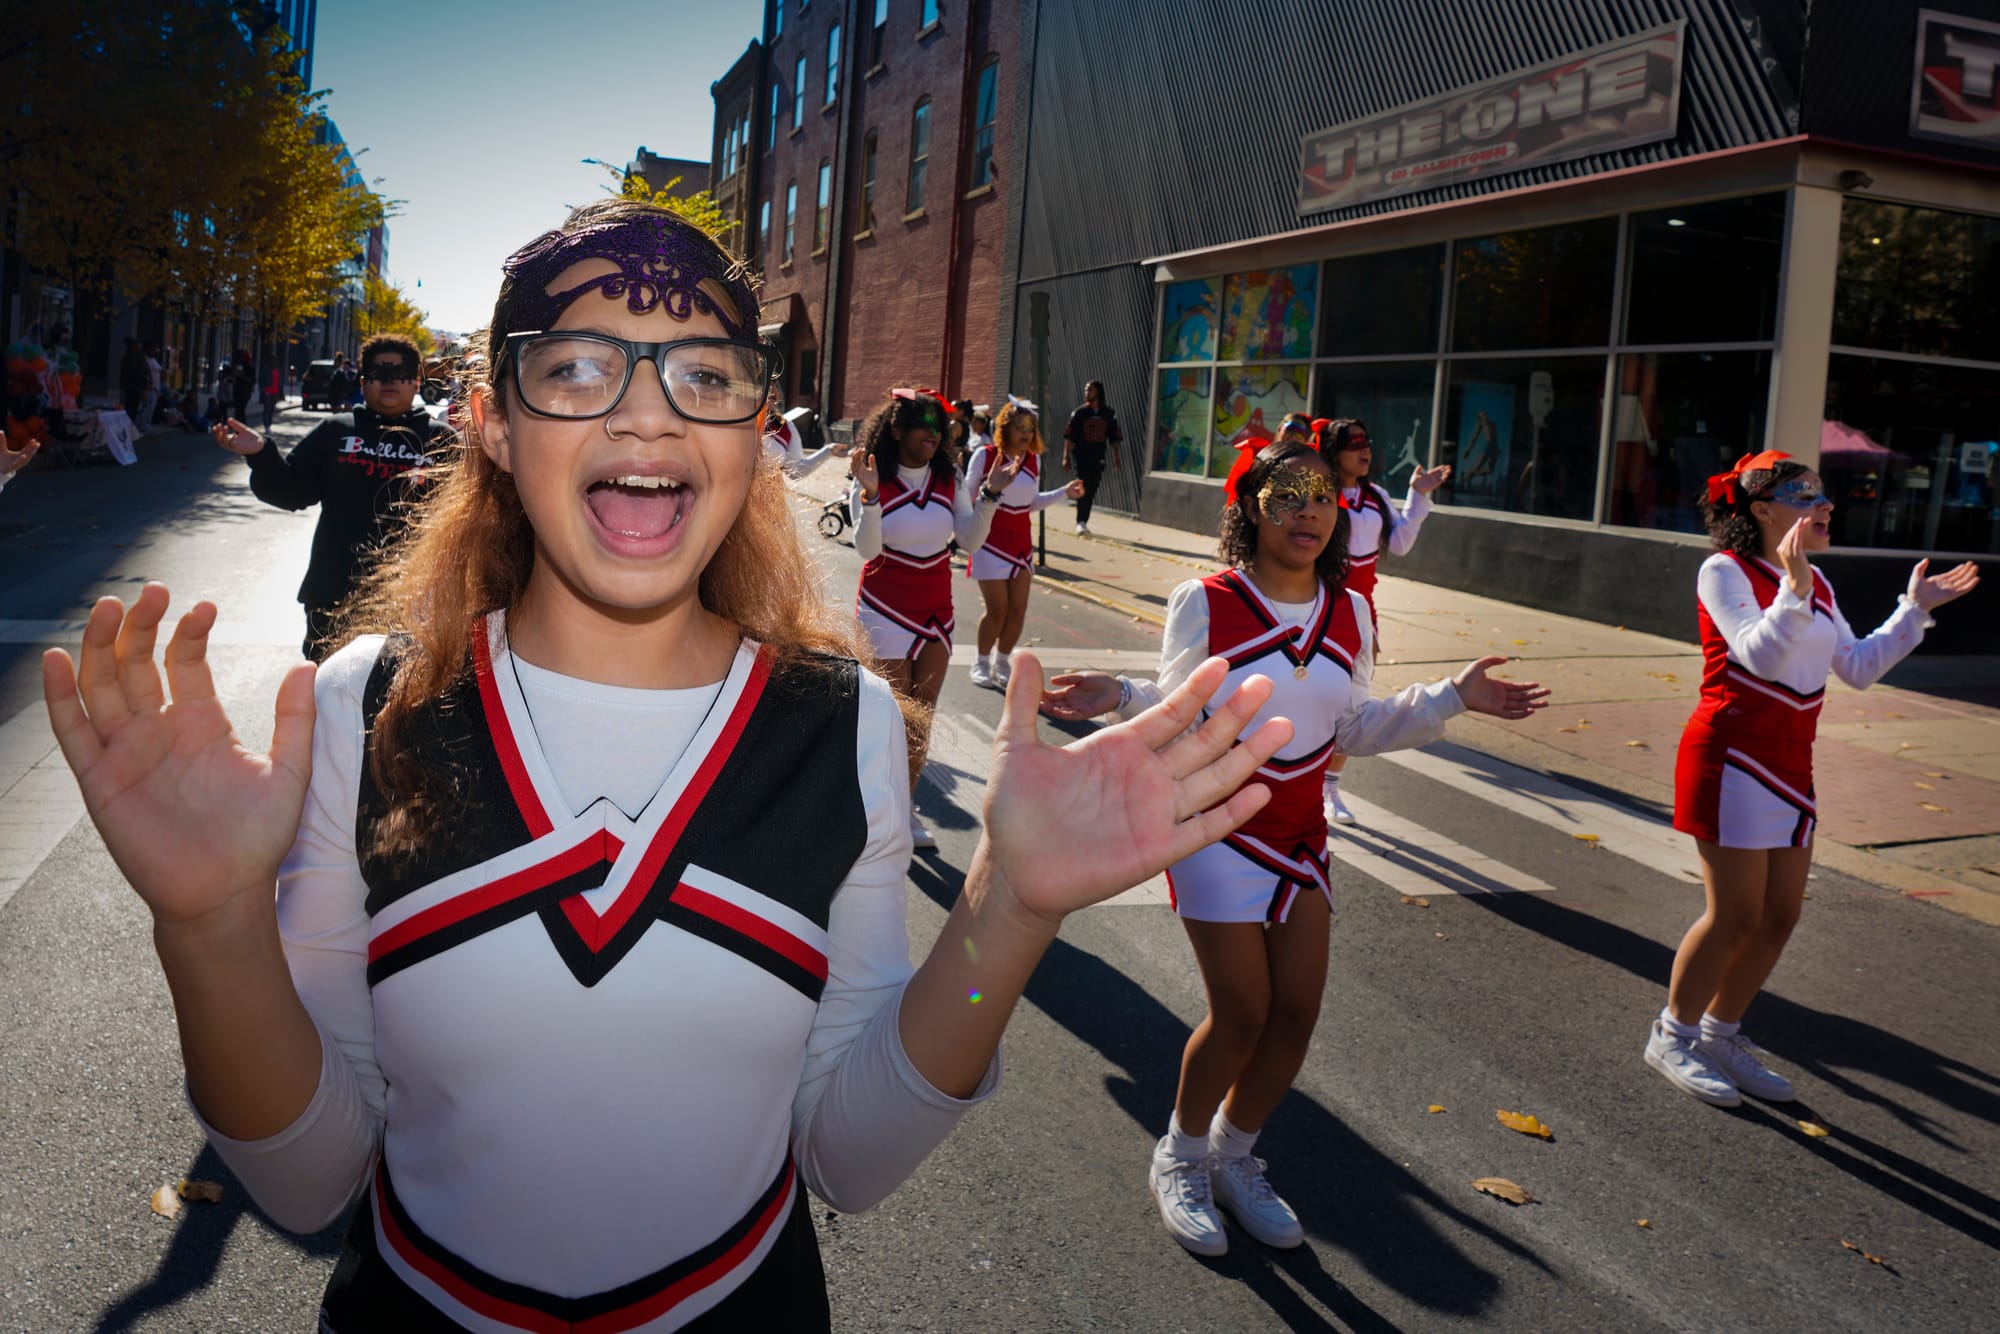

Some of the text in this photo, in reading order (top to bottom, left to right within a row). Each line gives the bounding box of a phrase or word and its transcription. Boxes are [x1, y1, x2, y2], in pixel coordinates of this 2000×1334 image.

[1314, 50, 1649, 178] THE ONE
[1391, 146, 1508, 181] IN ALLENTOWN
[338, 436, 434, 466] Bulldogs
